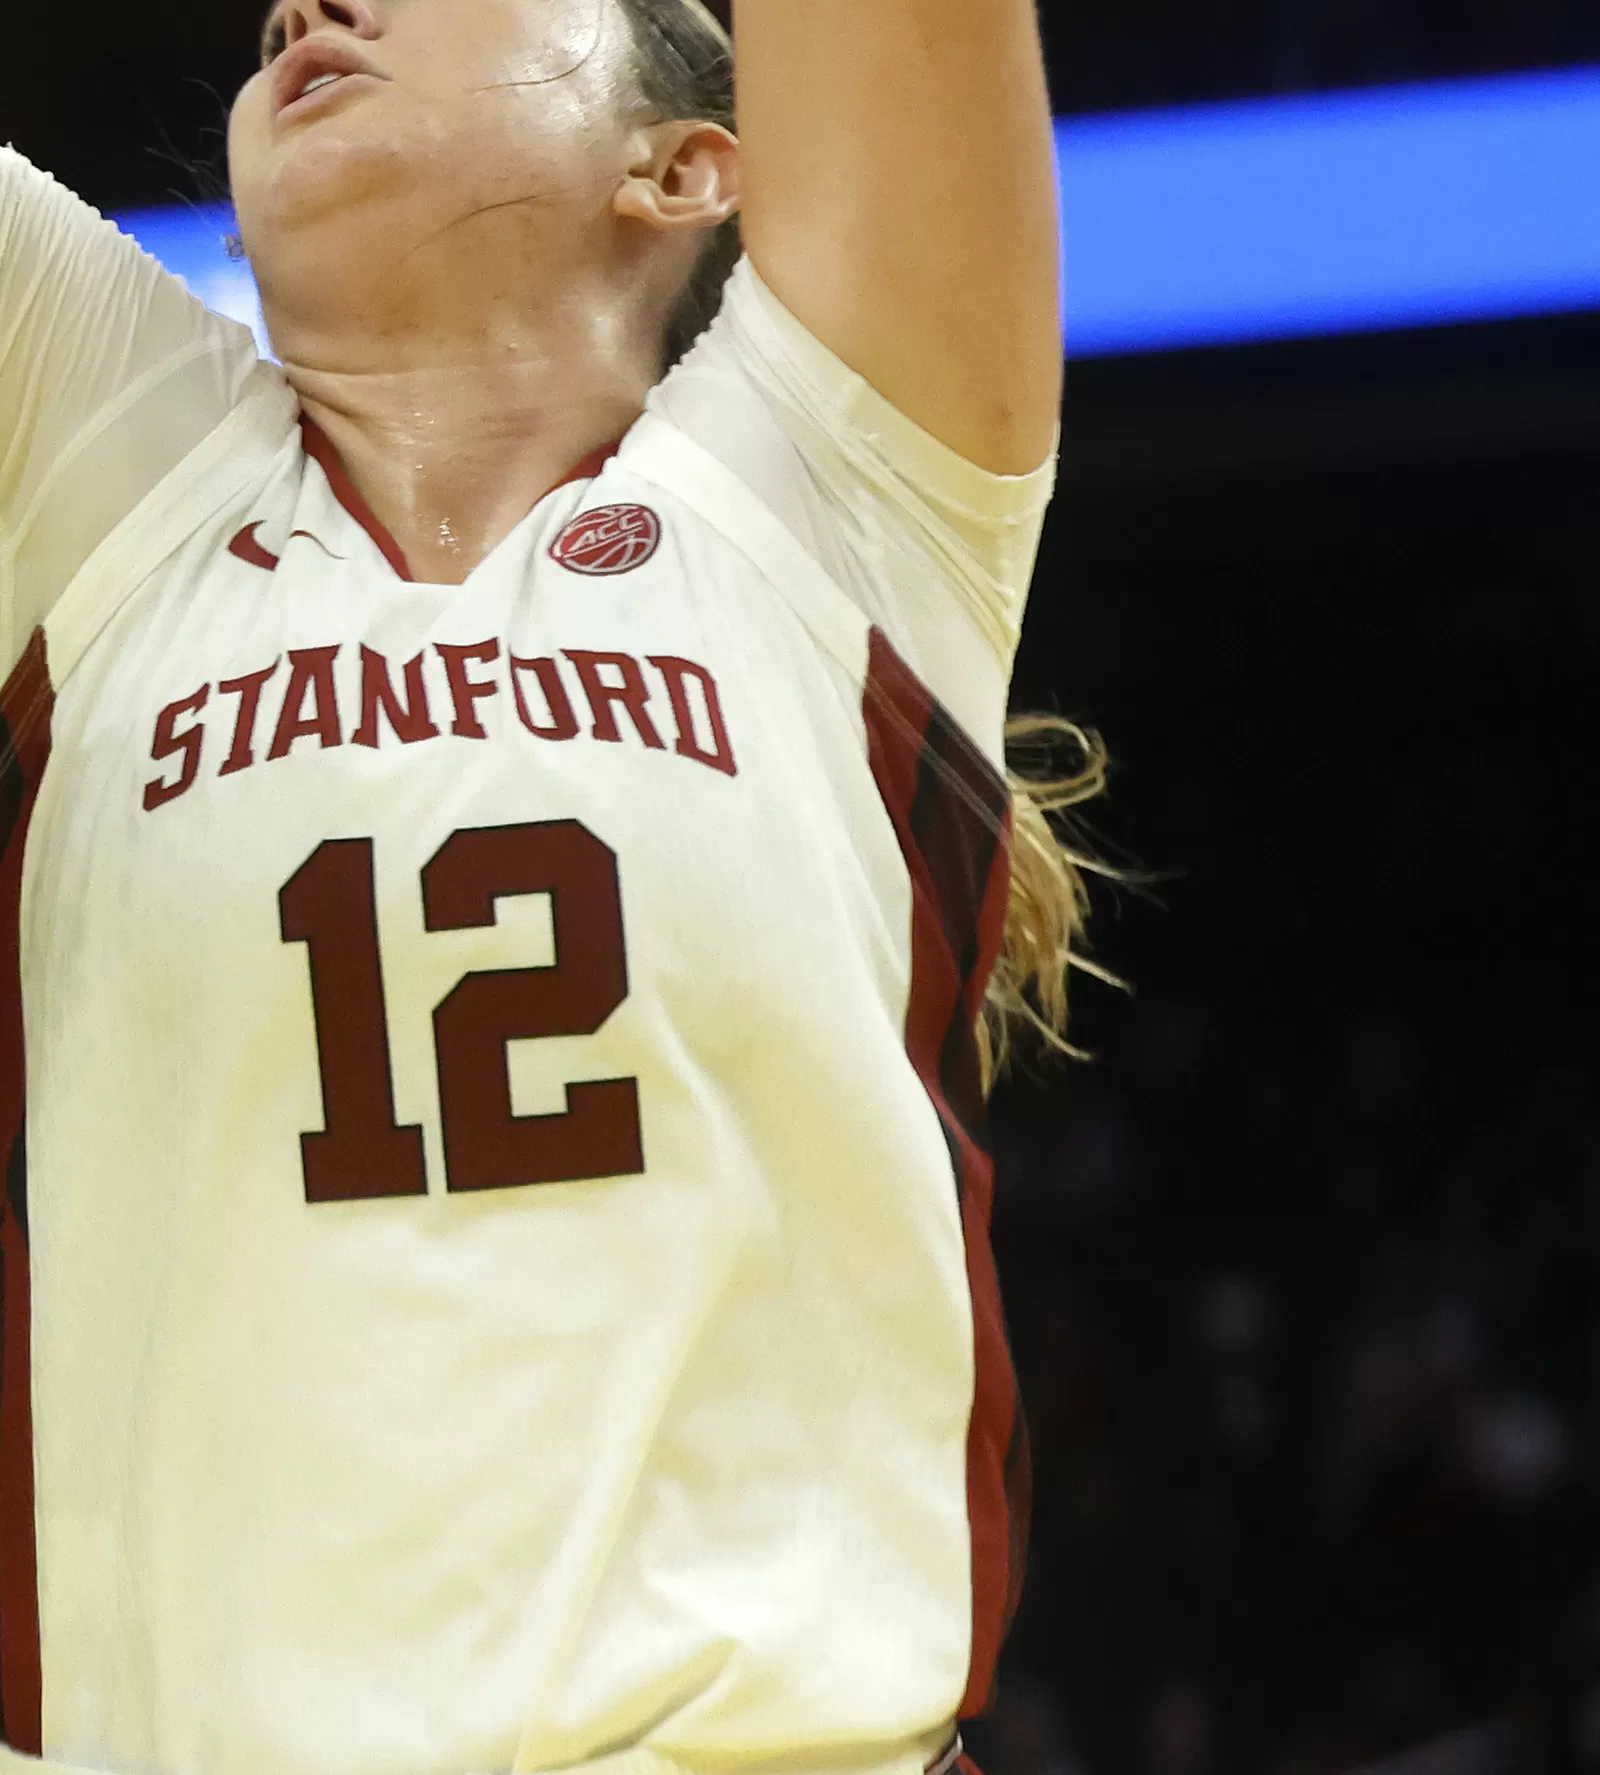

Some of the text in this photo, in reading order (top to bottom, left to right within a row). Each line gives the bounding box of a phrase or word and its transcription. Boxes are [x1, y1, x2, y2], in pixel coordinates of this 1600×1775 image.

[566, 508, 645, 554] ACC
[141, 636, 739, 812] STANFORD
[277, 817, 646, 1204] 12
